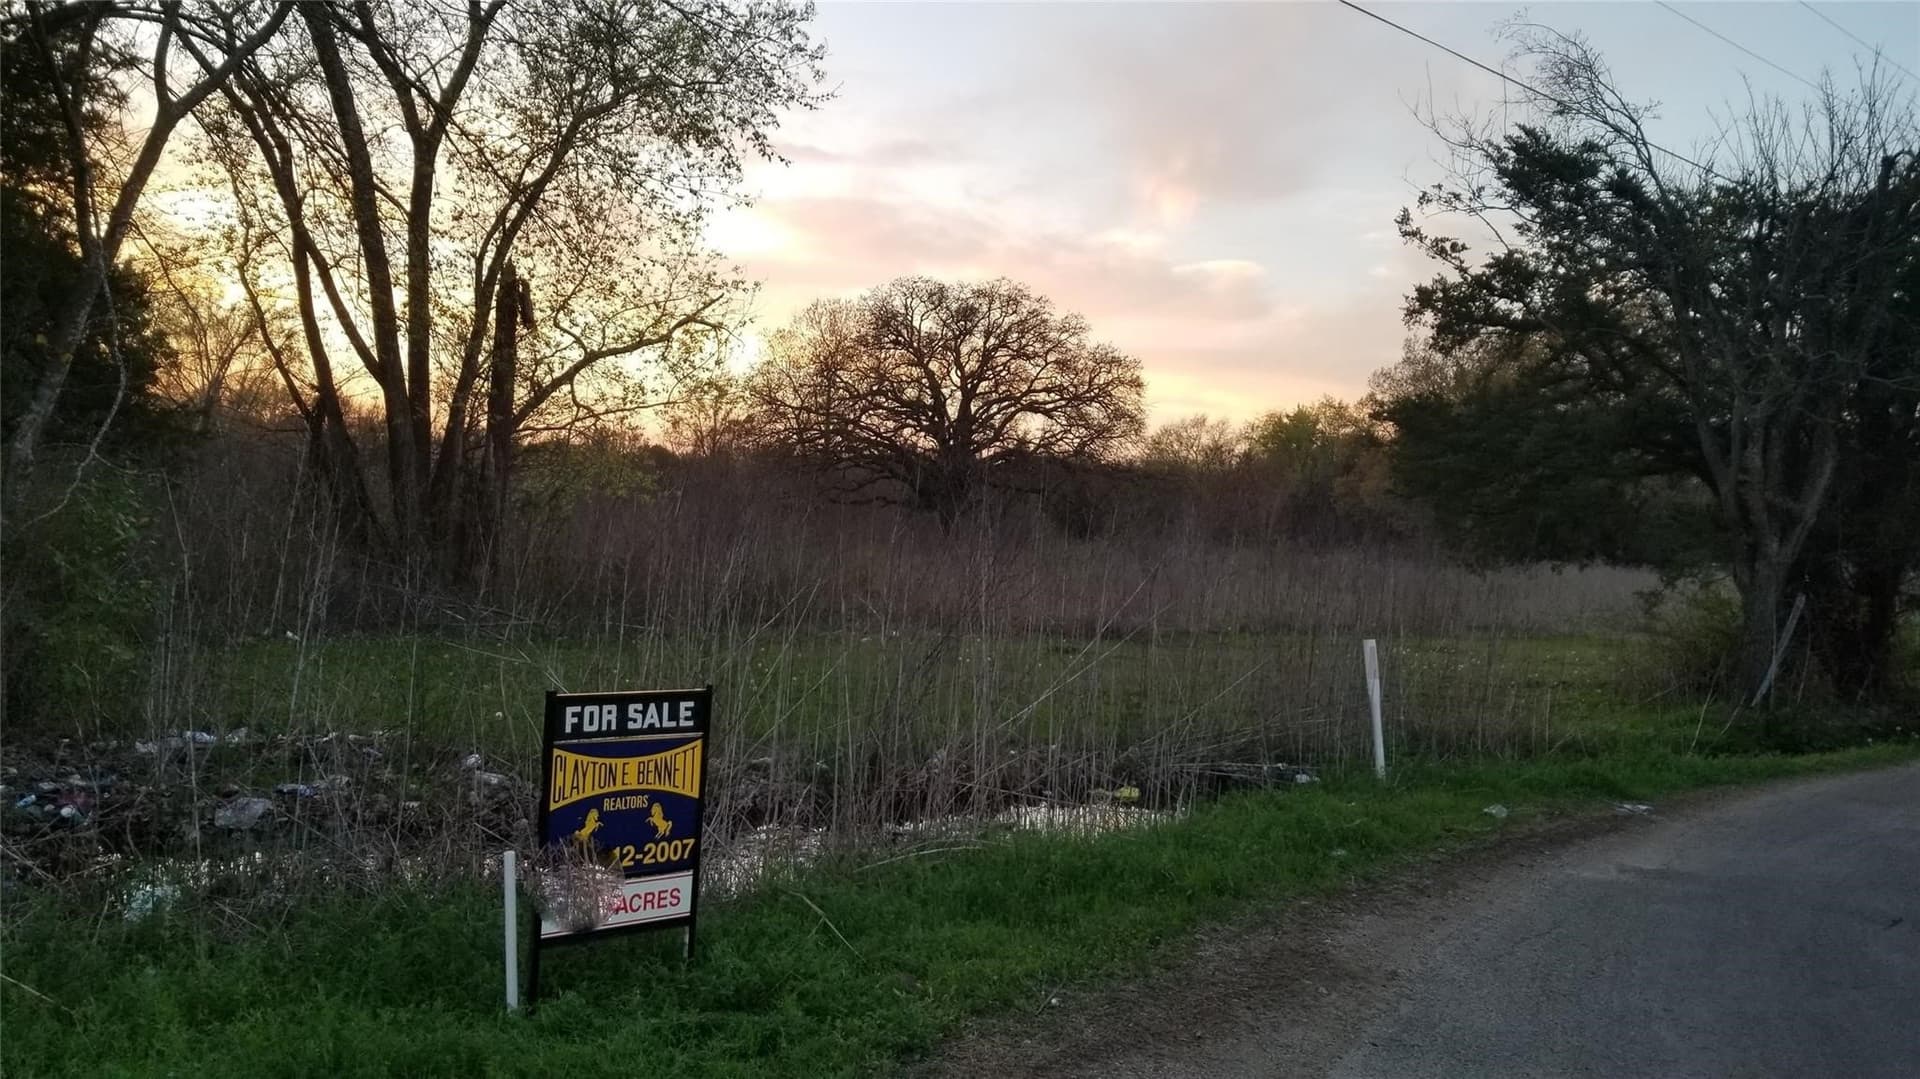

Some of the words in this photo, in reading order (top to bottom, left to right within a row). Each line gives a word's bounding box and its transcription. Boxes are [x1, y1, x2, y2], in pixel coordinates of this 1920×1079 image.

[565, 704, 617, 733] FOR
[627, 701, 695, 729] SALE
[553, 755, 617, 803] CLAYTON
[621, 762, 632, 785] E.
[637, 745, 698, 792] BENNETT
[603, 796, 649, 811] REALTORS
[614, 888, 681, 915] ACRES
